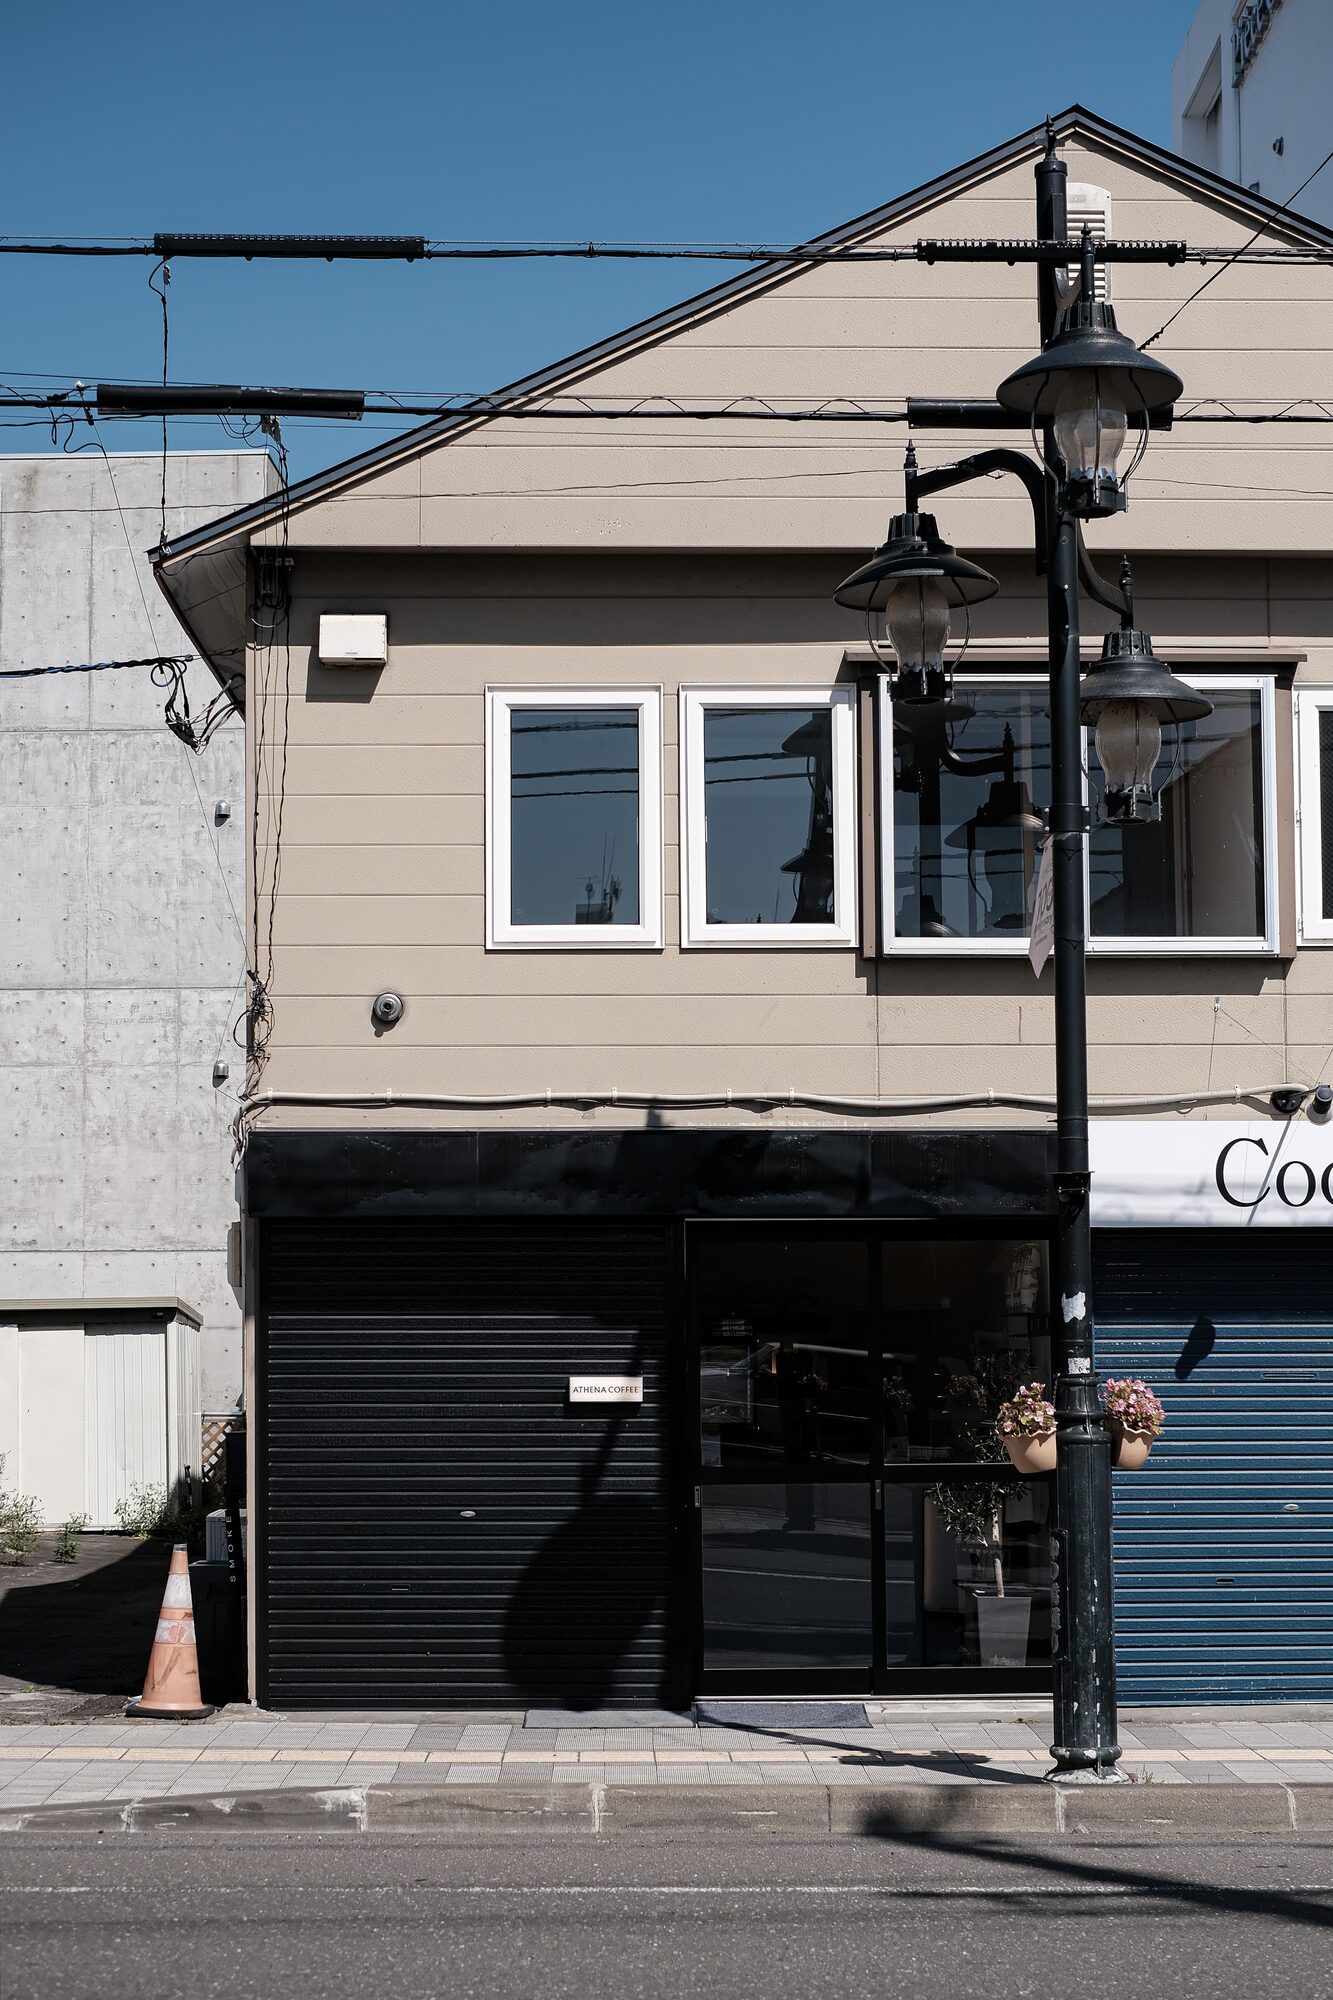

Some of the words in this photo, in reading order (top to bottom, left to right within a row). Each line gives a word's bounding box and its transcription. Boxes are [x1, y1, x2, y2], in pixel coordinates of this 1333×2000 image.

[572, 1385, 607, 1394] ATHENA
[607, 1385, 639, 1394] COFFEE
[225, 1515, 237, 1583] SMOKE
